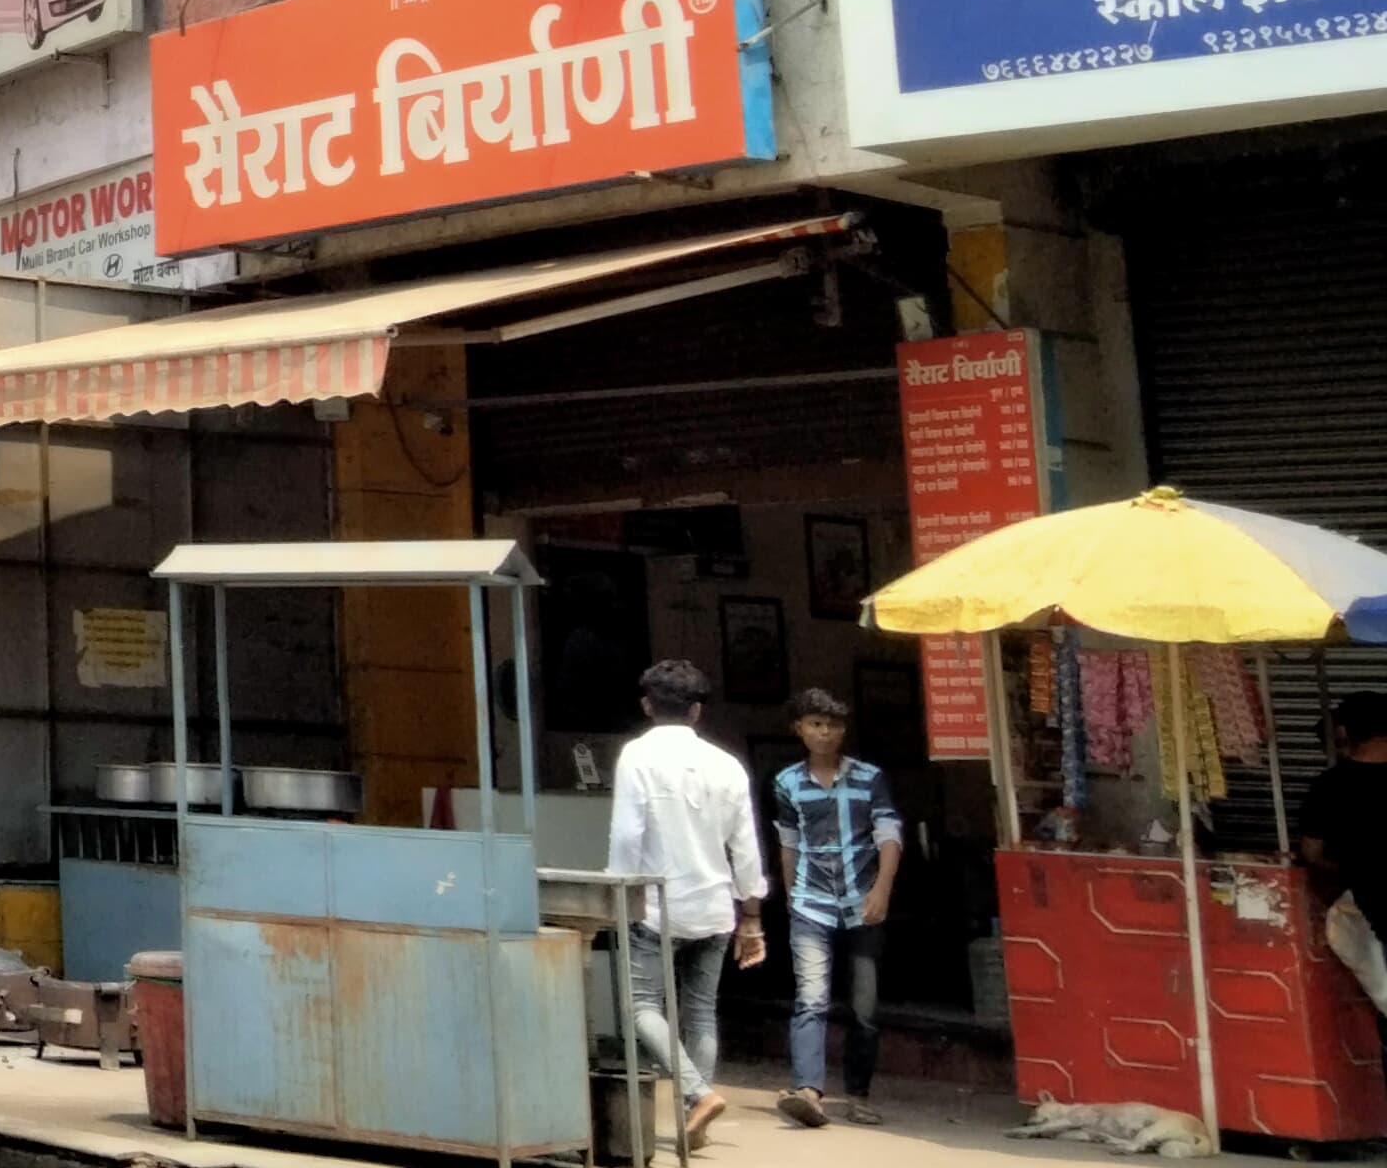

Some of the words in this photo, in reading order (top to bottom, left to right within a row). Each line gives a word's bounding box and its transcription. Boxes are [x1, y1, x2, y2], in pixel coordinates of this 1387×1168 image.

[181, 79, 356, 209] सैराट
[0, 192, 86, 255] MOTOR
[90, 171, 154, 228] WOR
[21, 251, 44, 271] Multi
[46, 241, 76, 265] Brand
[78, 234, 95, 254] Car
[97, 223, 151, 247] Workshop
[953, 349, 1022, 382] बिर्याणी
